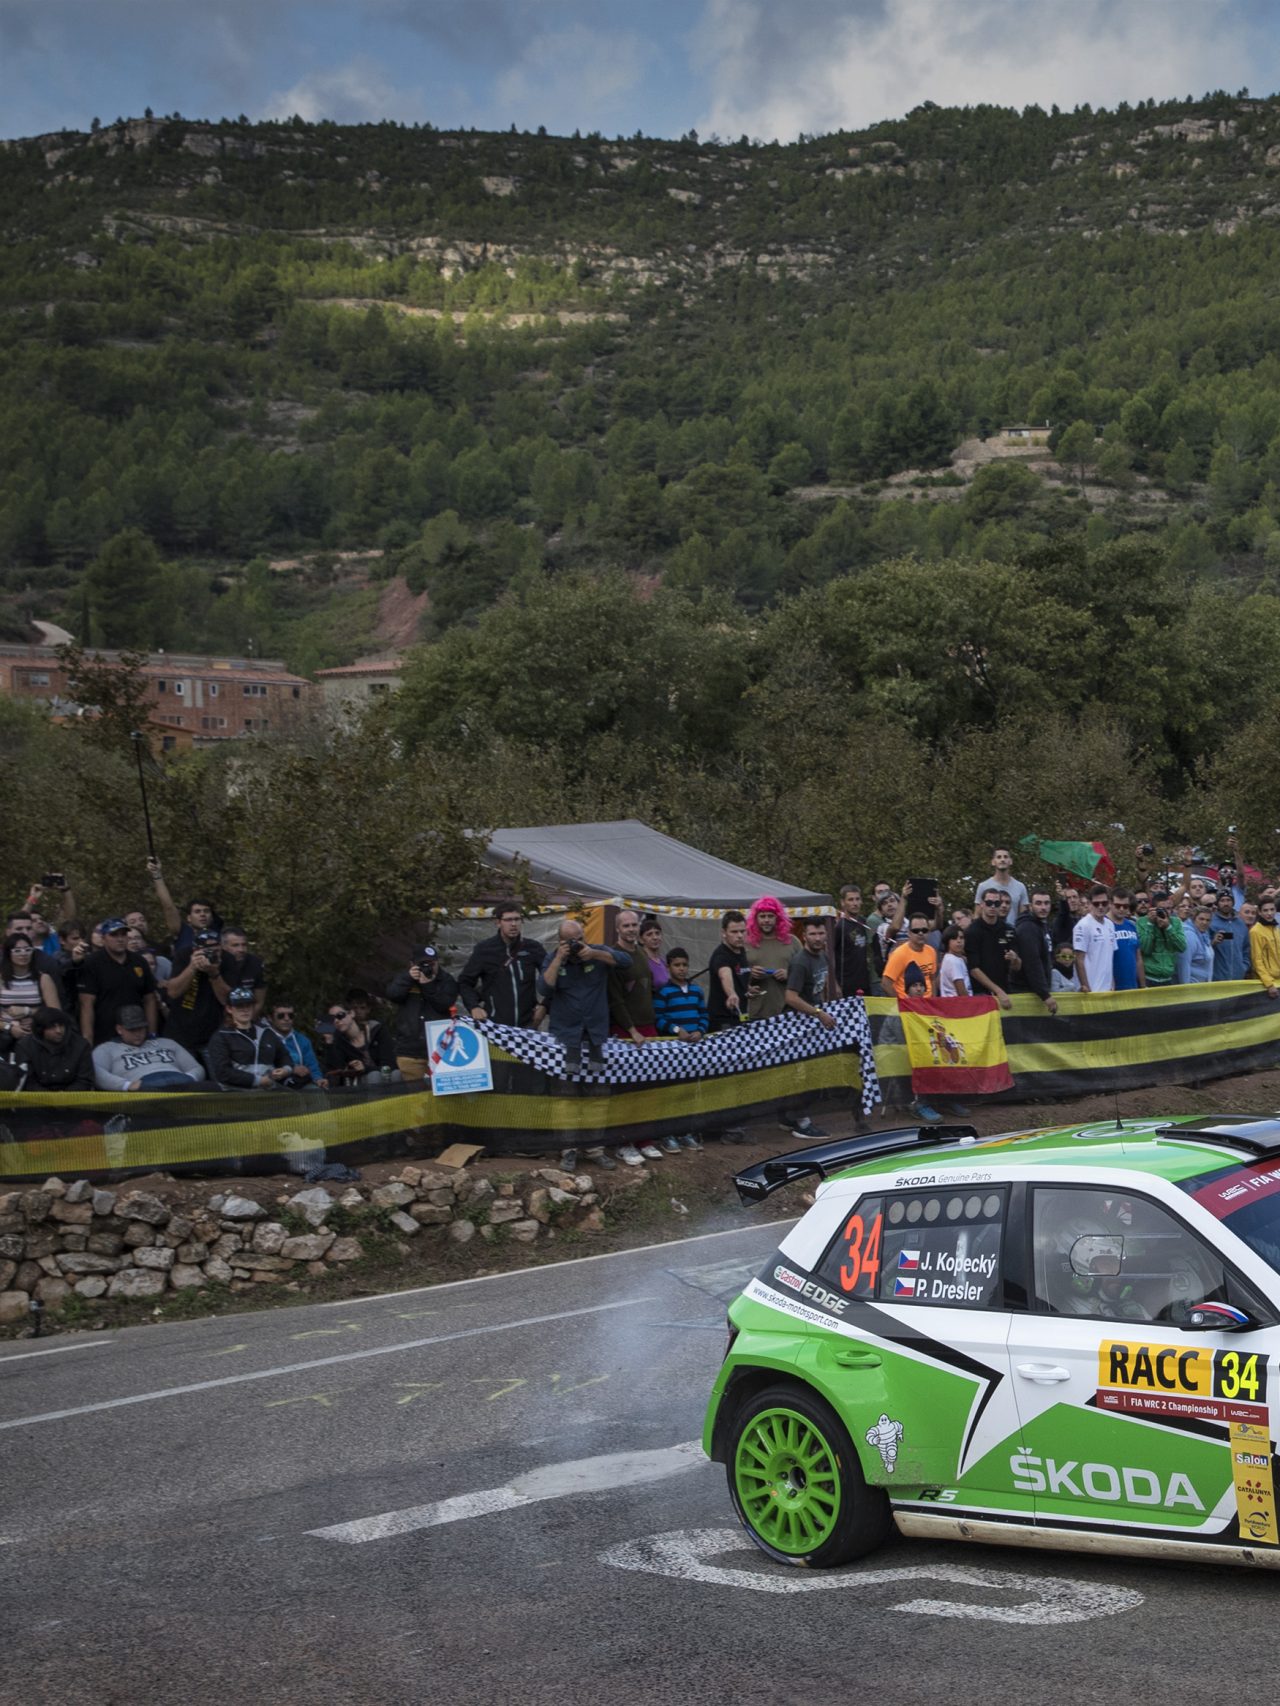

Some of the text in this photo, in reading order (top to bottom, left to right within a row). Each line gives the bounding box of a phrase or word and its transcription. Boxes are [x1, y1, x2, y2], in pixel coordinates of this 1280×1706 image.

[895, 1172, 992, 1187] ŠKODA Genuine Parts
[1249, 1175, 1272, 1188] FIA
[840, 1212, 883, 1292] 34
[920, 1251, 997, 1279] J. Kopecký
[780, 1270, 803, 1290] Castrol
[916, 1279, 984, 1301] P. Dresler
[801, 1281, 851, 1315] EDGE
[1109, 1344, 1200, 1391] RACC
[1221, 1351, 1260, 1400] 34
[1130, 1397, 1219, 1416] FIA WRC 2 Championship
[1235, 1453, 1268, 1466] Salou
[1009, 1447, 1206, 1511] ŠKODA
[918, 1489, 959, 1502] R5
[1237, 1486, 1272, 1497] CATALUNYA
